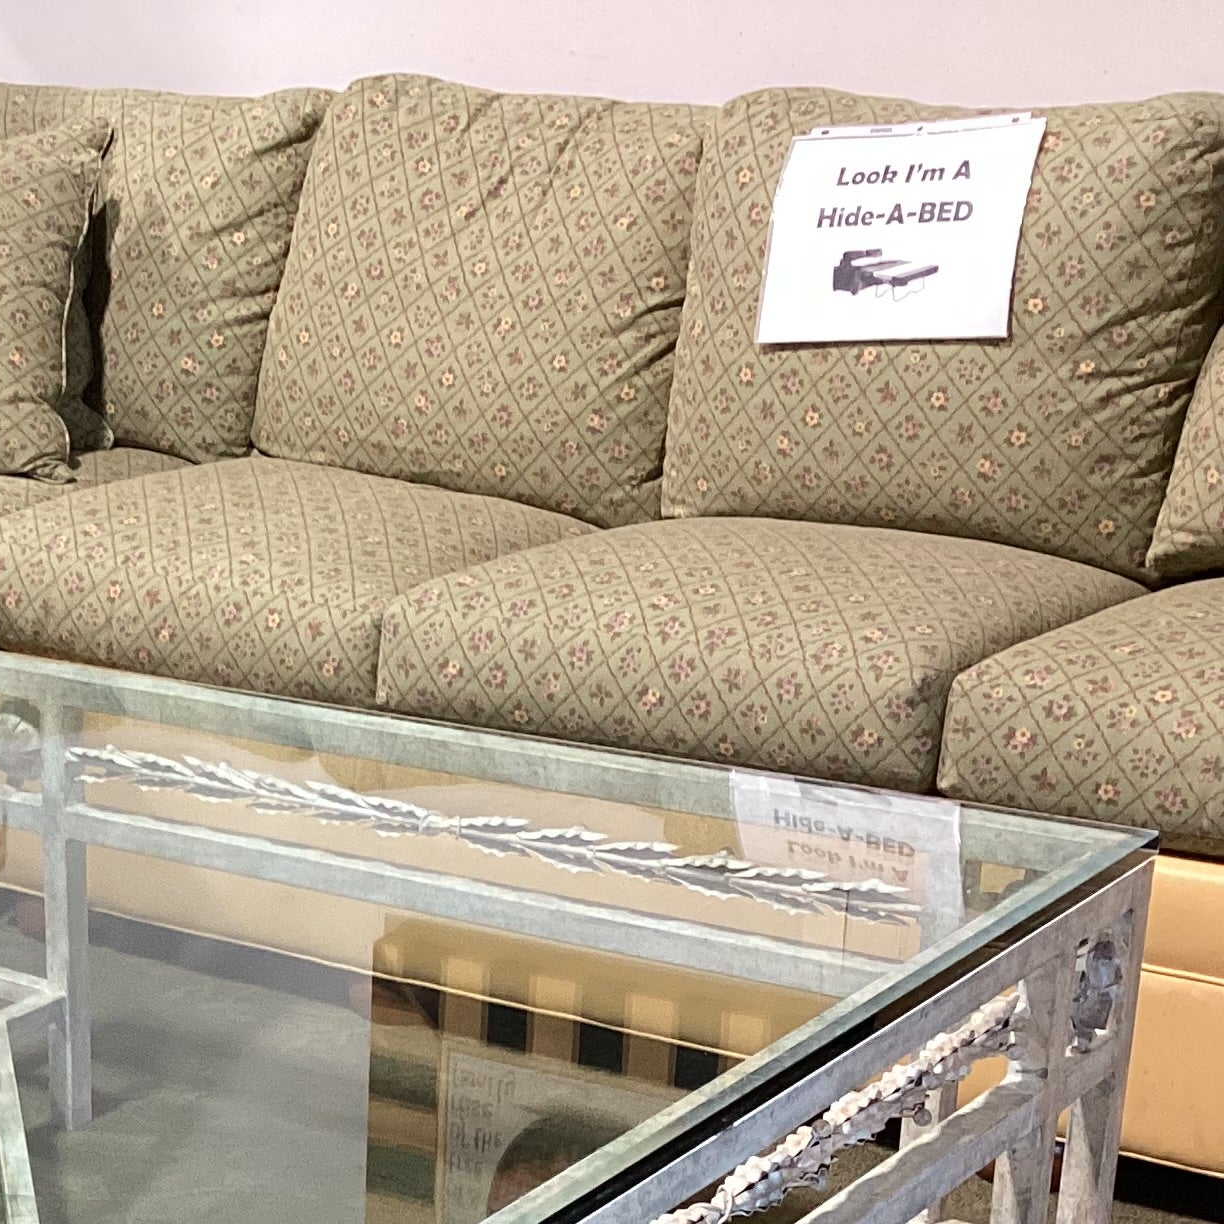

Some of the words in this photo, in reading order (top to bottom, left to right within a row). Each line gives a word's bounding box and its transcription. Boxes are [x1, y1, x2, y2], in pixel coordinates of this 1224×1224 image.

[836, 164, 898, 187] Look
[904, 162, 945, 184] I'm
[951, 160, 971, 180] A
[816, 200, 974, 228] Hide-A-BED
